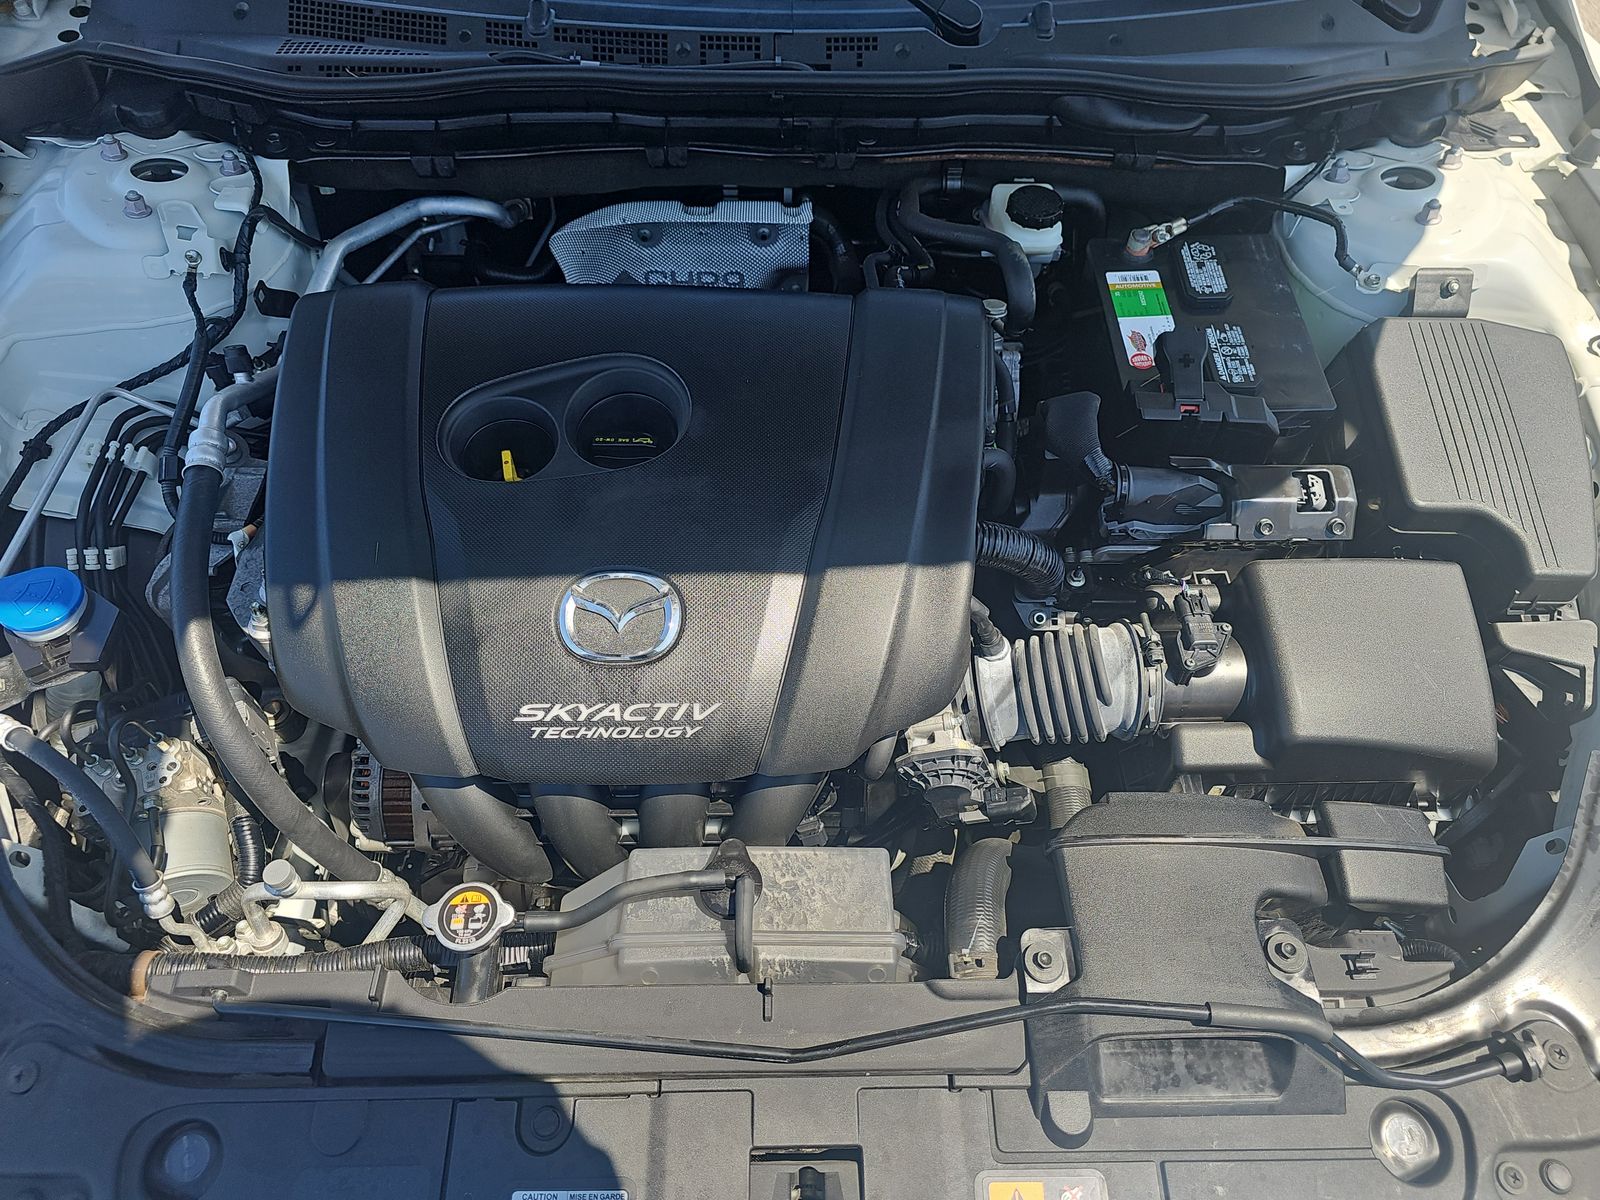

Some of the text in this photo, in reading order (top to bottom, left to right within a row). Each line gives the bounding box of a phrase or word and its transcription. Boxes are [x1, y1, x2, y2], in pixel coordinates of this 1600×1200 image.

[1212, 352, 1226, 375] DANGER
[511, 702, 724, 723] SKYACTIV
[529, 726, 703, 740] TECHNOLOGY
